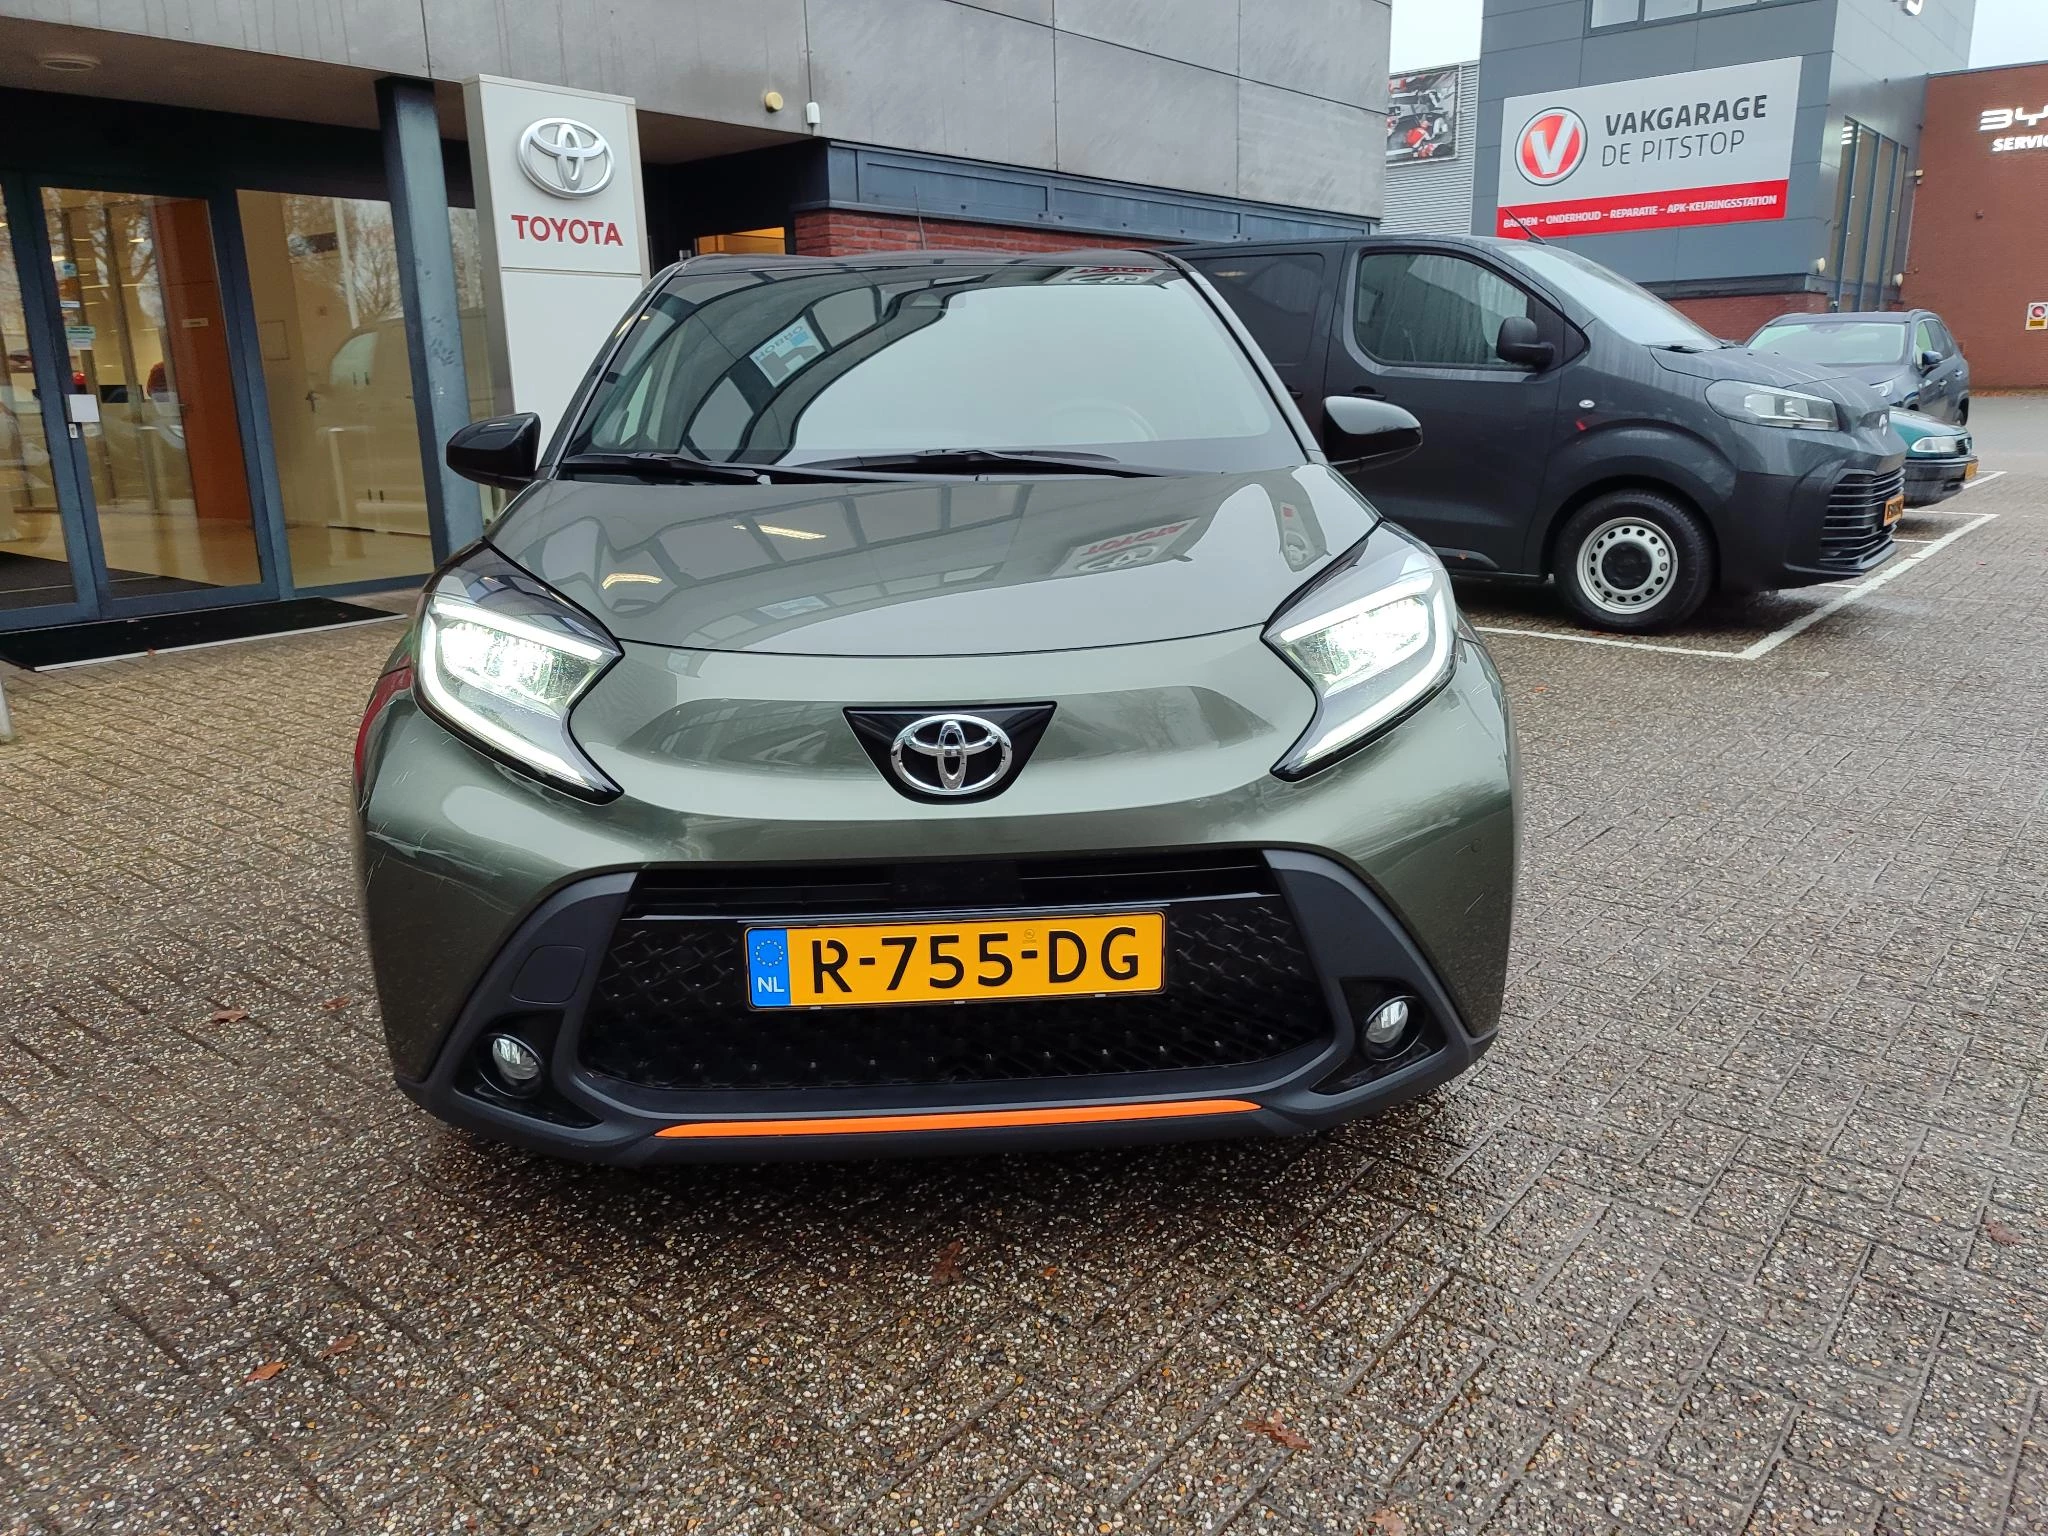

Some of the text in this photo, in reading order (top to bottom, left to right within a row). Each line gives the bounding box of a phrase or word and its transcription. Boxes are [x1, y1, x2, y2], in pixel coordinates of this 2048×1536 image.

[1605, 94, 1768, 137] VAKGARAGE
[1602, 129, 1745, 167] DE PITSTOP
[1545, 210, 1602, 225] ONDERHOUD
[1609, 205, 1659, 219] REPARATIE
[1666, 194, 1778, 214] APK-KEURINGSSTATION
[511, 214, 624, 247] TOYOTA
[811, 926, 1140, 994] R-755-DG
[757, 977, 785, 994] NL
